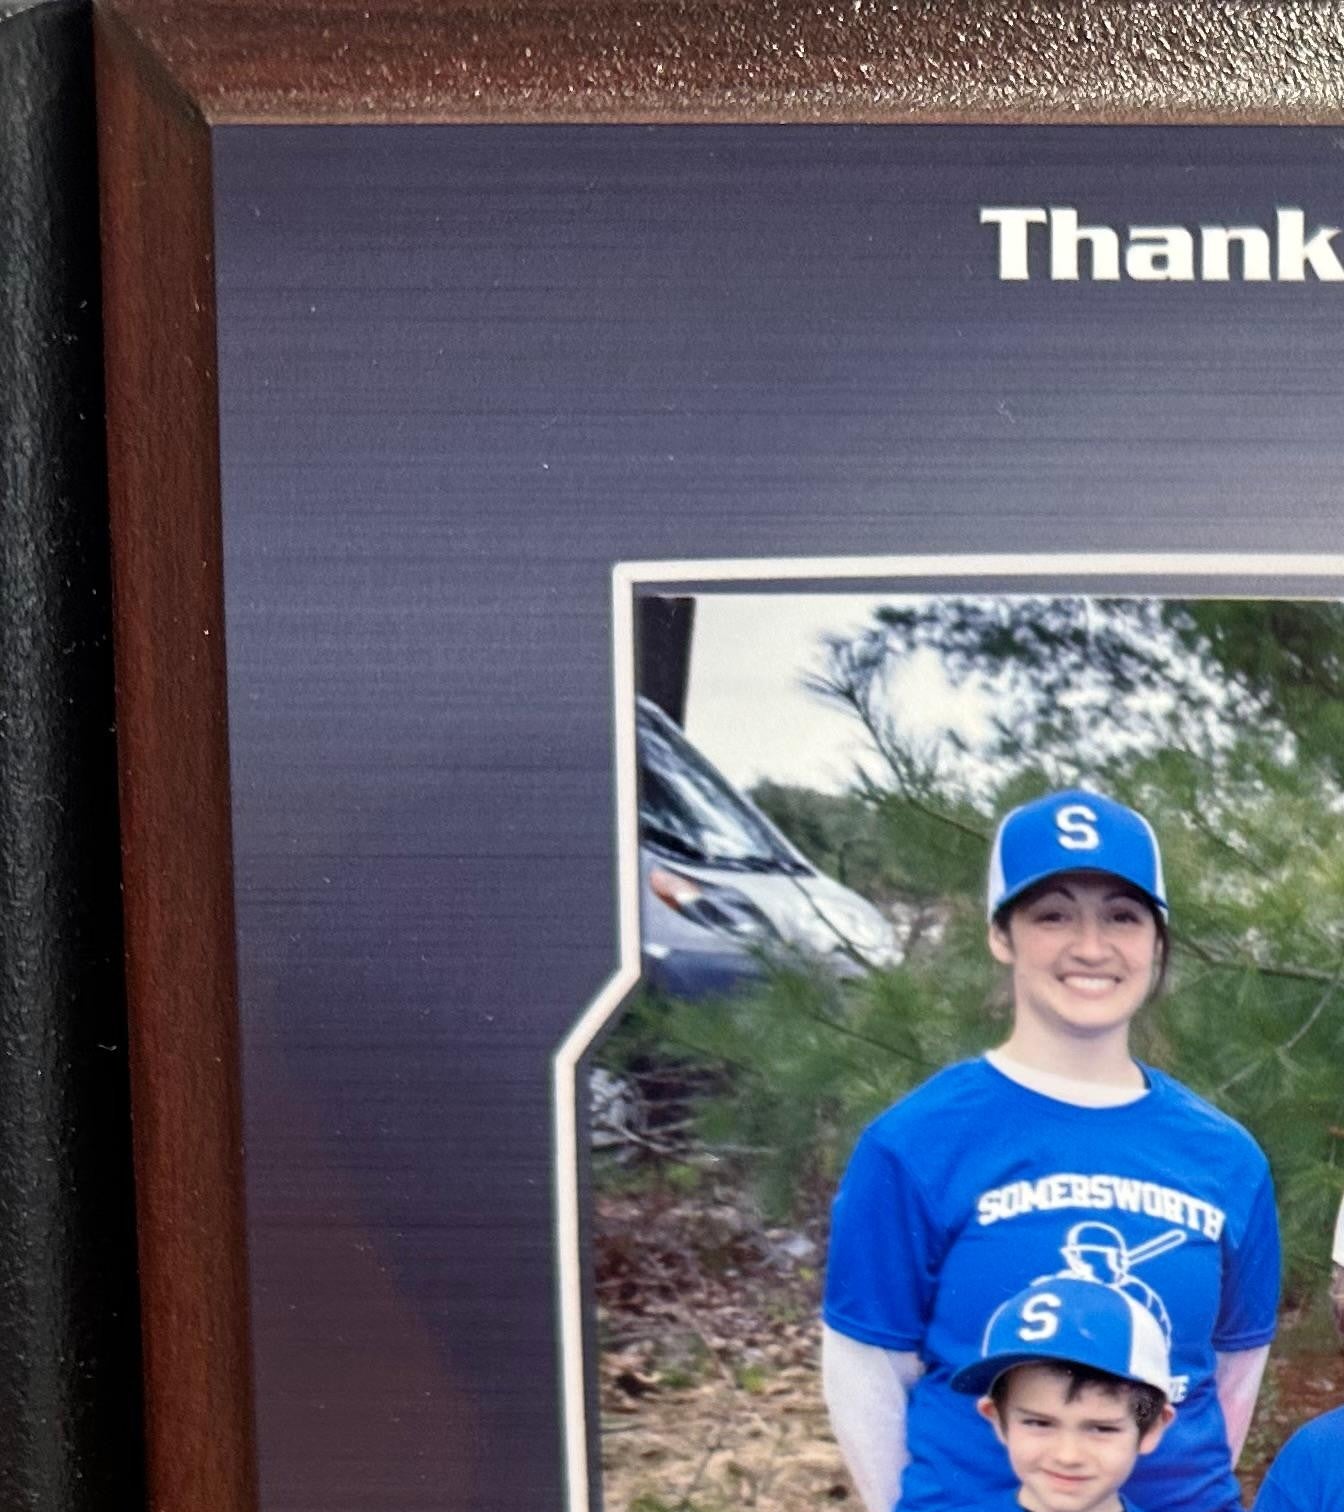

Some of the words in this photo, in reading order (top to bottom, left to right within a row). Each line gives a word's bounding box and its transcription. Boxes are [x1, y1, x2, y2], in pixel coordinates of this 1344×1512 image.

[1055, 804, 1100, 851] S
[977, 1172, 1226, 1243] SOMERSWORTH
[1018, 1292, 1063, 1342] S
